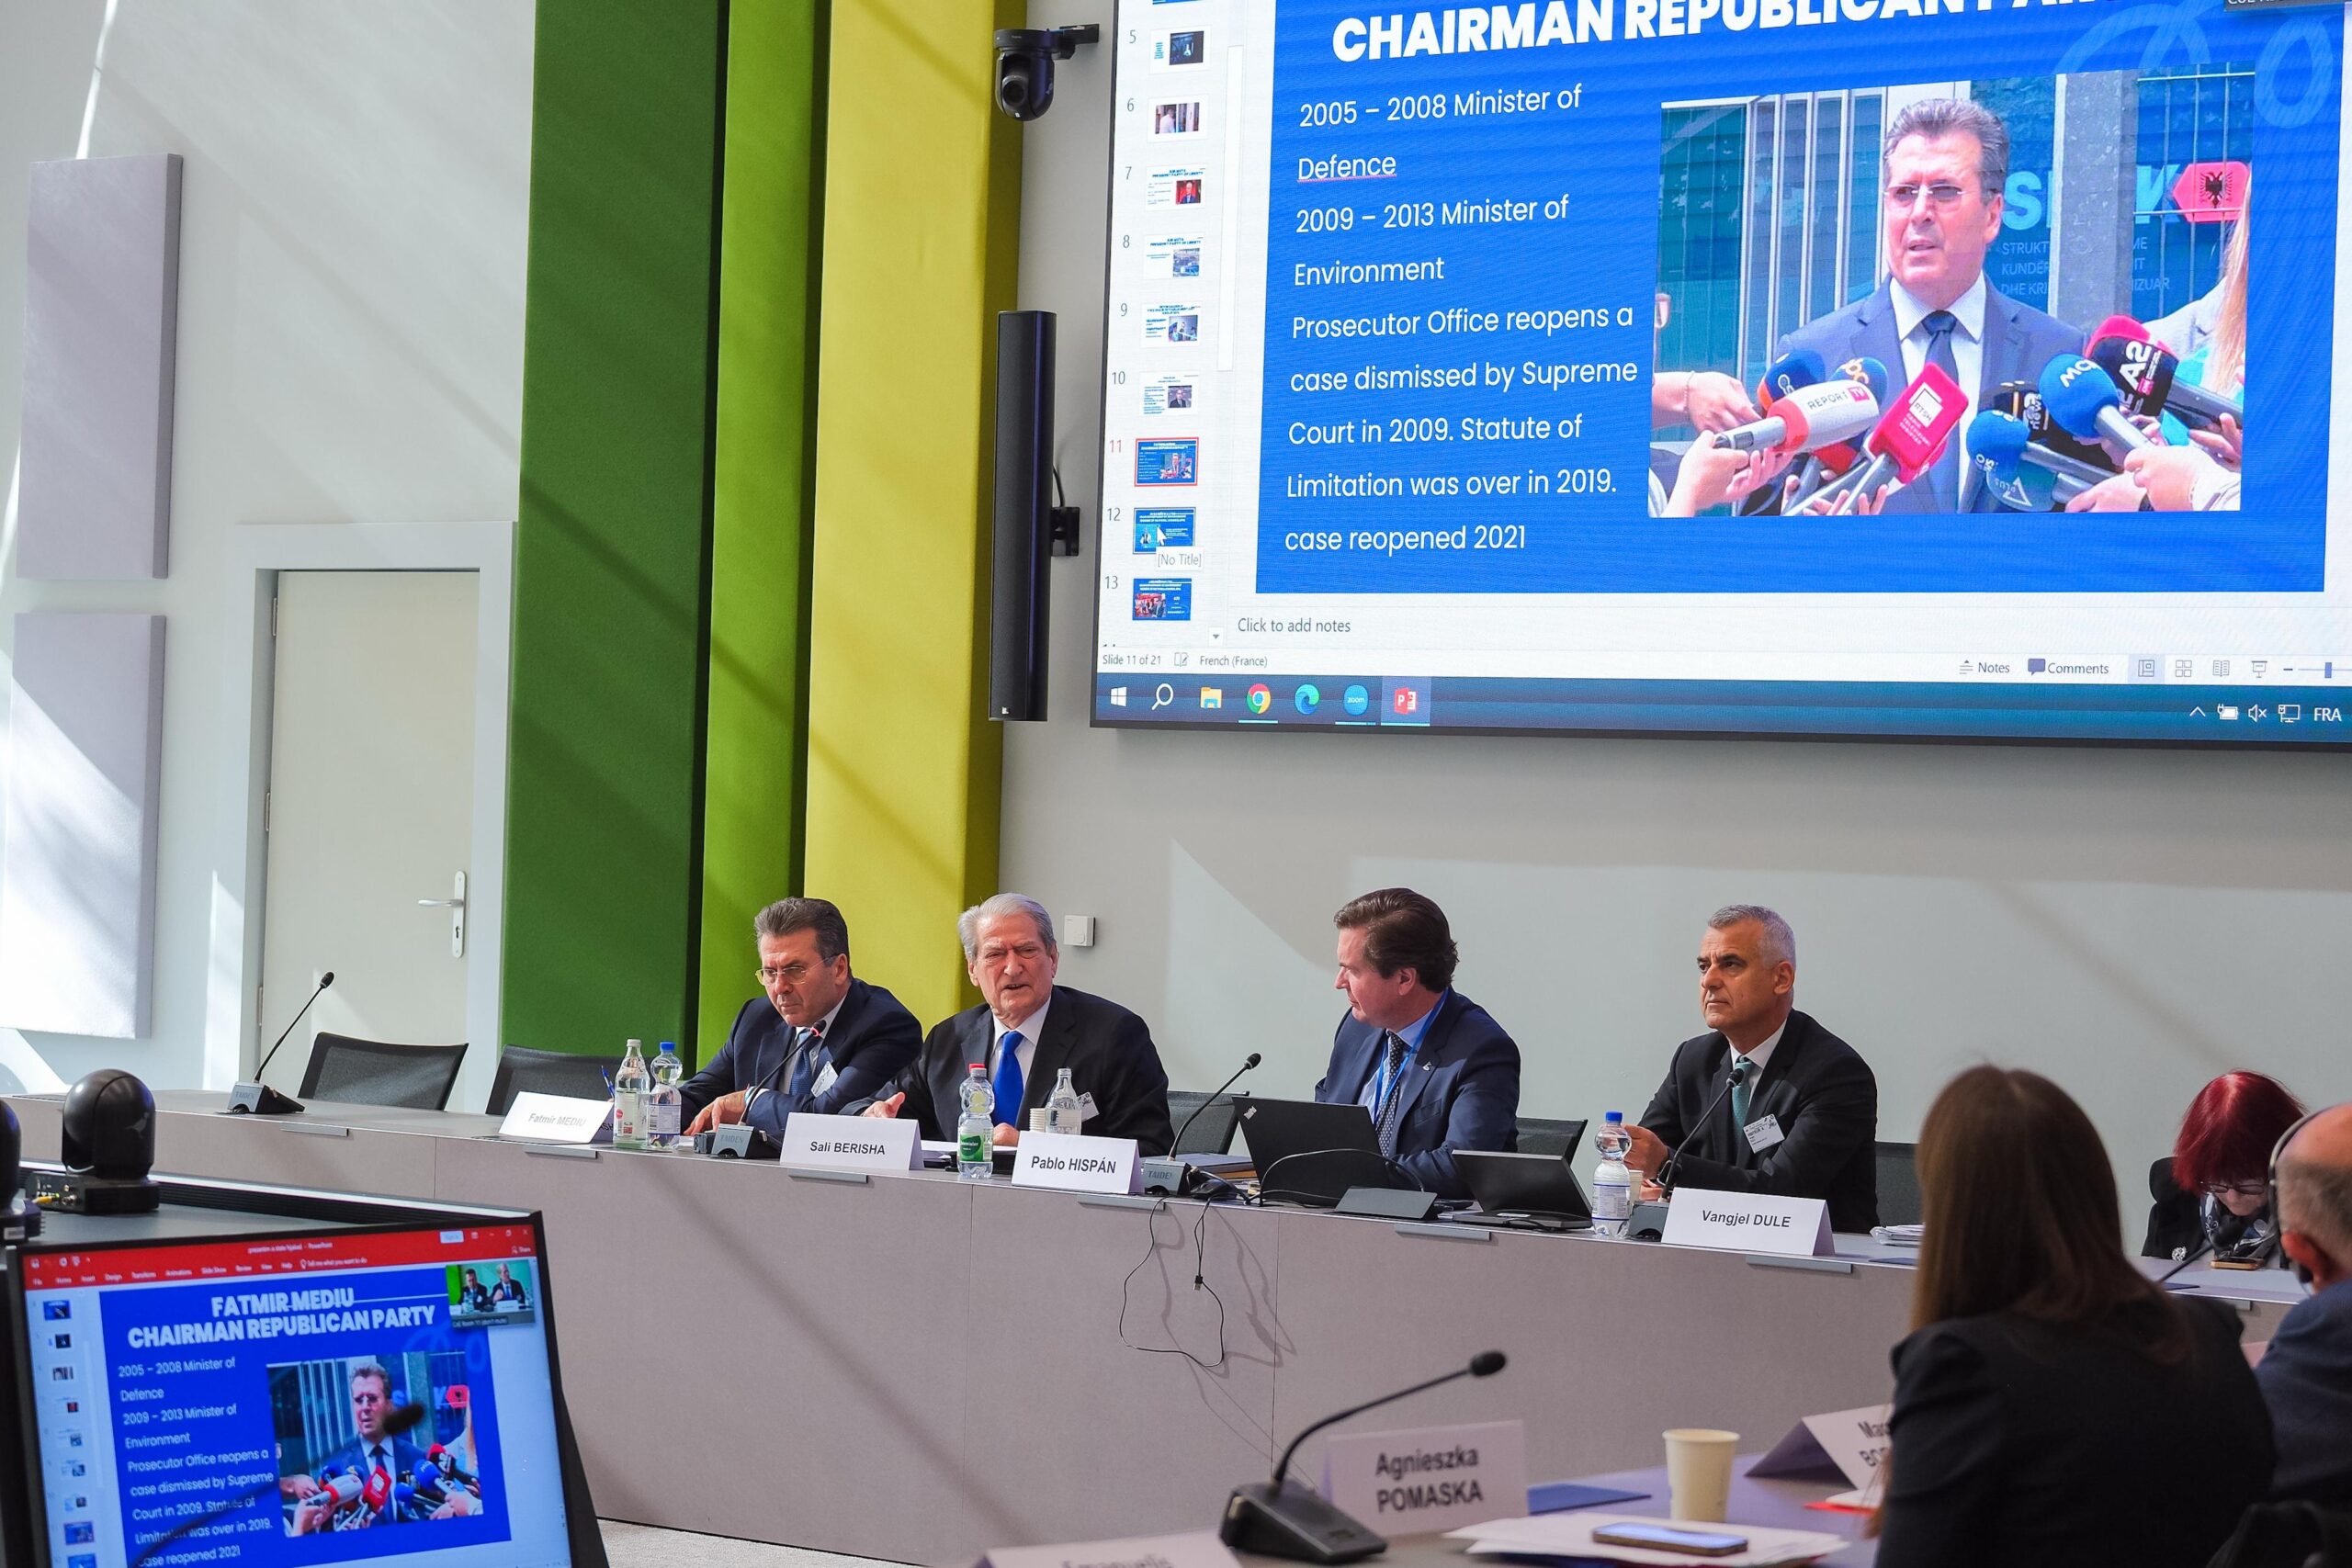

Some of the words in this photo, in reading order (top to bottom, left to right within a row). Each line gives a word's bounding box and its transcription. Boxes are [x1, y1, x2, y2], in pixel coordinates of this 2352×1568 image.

[1129, 29, 1136, 43] 5
[1332, 0, 1613, 62] CHAIRMAN
[1126, 97, 1135, 112] 6
[1299, 100, 1358, 128] 2005
[1386, 94, 1446, 121] 2008
[1454, 88, 1551, 118] Minister
[1556, 83, 1583, 109] of
[1125, 166, 1132, 180] 7
[1298, 153, 1397, 180] Defence
[1295, 207, 1354, 233] 2009
[1383, 202, 1434, 229] 2013
[1442, 197, 1538, 226] Minister
[1544, 193, 1569, 220] of
[1123, 234, 1130, 249] 8
[1295, 257, 1446, 286] Environment
[1121, 303, 1128, 317] 9
[1292, 313, 1421, 340] Prosecutor
[1427, 307, 1499, 334] Office
[1506, 306, 1610, 338] reopens
[1615, 306, 1634, 328] a
[1112, 371, 1125, 385] 10
[1290, 371, 1348, 393] case
[1354, 362, 1477, 391] dismissed
[1484, 362, 1516, 393] by
[1521, 360, 1638, 392] Supreme
[1807, 391, 1849, 410] REPORT
[1288, 421, 1355, 446] Court
[1361, 418, 1382, 444] in
[1389, 417, 1454, 443] 2009.
[1461, 415, 1551, 441] Statute
[1557, 412, 1583, 440] of
[1109, 439, 1122, 453] 11
[1287, 471, 1403, 499] Limitation
[1409, 477, 1459, 497] was
[1466, 475, 1521, 496] over
[1528, 468, 1550, 495] in
[1556, 468, 1618, 494] 2019.
[1107, 507, 1121, 522] 12
[1284, 531, 1342, 552] case
[1349, 524, 1466, 558] reopened
[1474, 524, 1526, 550] 2021
[1157, 553, 1175, 568] [No
[1179, 552, 1202, 568] Title]
[1105, 575, 1118, 590] 13
[1237, 616, 1267, 634] Click
[1270, 618, 1284, 634] to
[1287, 616, 1312, 634] add
[1315, 619, 1351, 634] notes
[1102, 654, 1124, 665] Slide
[1126, 655, 1137, 665] 11
[1139, 654, 1149, 665] of
[1150, 655, 1161, 666] 21
[1200, 655, 1229, 667] French
[1231, 655, 1269, 668] (France)
[1977, 661, 2010, 674] Notes
[2047, 662, 2109, 675] Comments
[2313, 707, 2342, 722] FRA
[528, 1112, 557, 1124] Fatmir
[557, 1115, 587, 1127] MEDIU
[809, 1141, 831, 1153] Sali
[833, 1142, 886, 1156] BERISHA
[1031, 1155, 1066, 1170] Pablo
[1068, 1156, 1116, 1174] HISPÁN
[1702, 1210, 1750, 1226] Vangjel
[1752, 1213, 1792, 1228] DULE
[211, 1293, 290, 1318] FATMIR
[290, 1288, 356, 1311] MEDIU
[127, 1319, 245, 1348] CHAIRMAN
[246, 1311, 371, 1339] REPUBLICAN
[372, 1304, 435, 1329] PARTY
[118, 1363, 145, 1377] 2005
[155, 1361, 182, 1375] 2008
[183, 1359, 223, 1371] Minister
[224, 1356, 236, 1369] of
[120, 1388, 164, 1402] Defence
[123, 1412, 150, 1426] 2009
[161, 1408, 183, 1422] 2013
[185, 1406, 224, 1420] Minister
[226, 1403, 237, 1416] of
[125, 1432, 191, 1450] Environment
[127, 1458, 184, 1473] Prosecutor
[186, 1453, 216, 1467] Office
[217, 1450, 259, 1465] reopens
[261, 1449, 269, 1459] a
[1375, 1445, 1478, 1481] Agnieszka
[130, 1485, 157, 1497] case
[158, 1477, 211, 1495] dismissed
[211, 1475, 226, 1490] by
[227, 1472, 274, 1487] Supreme
[1376, 1480, 1484, 1513] POMASKA
[131, 1507, 163, 1521] Court
[164, 1506, 175, 1517] in
[175, 1502, 206, 1516] 2009.
[188, 1526, 210, 1538] was
[211, 1524, 235, 1536] over
[236, 1520, 246, 1532] in
[247, 1517, 273, 1531] 2019.
[165, 1548, 217, 1566] reopened
[219, 1545, 241, 1558] 2021
